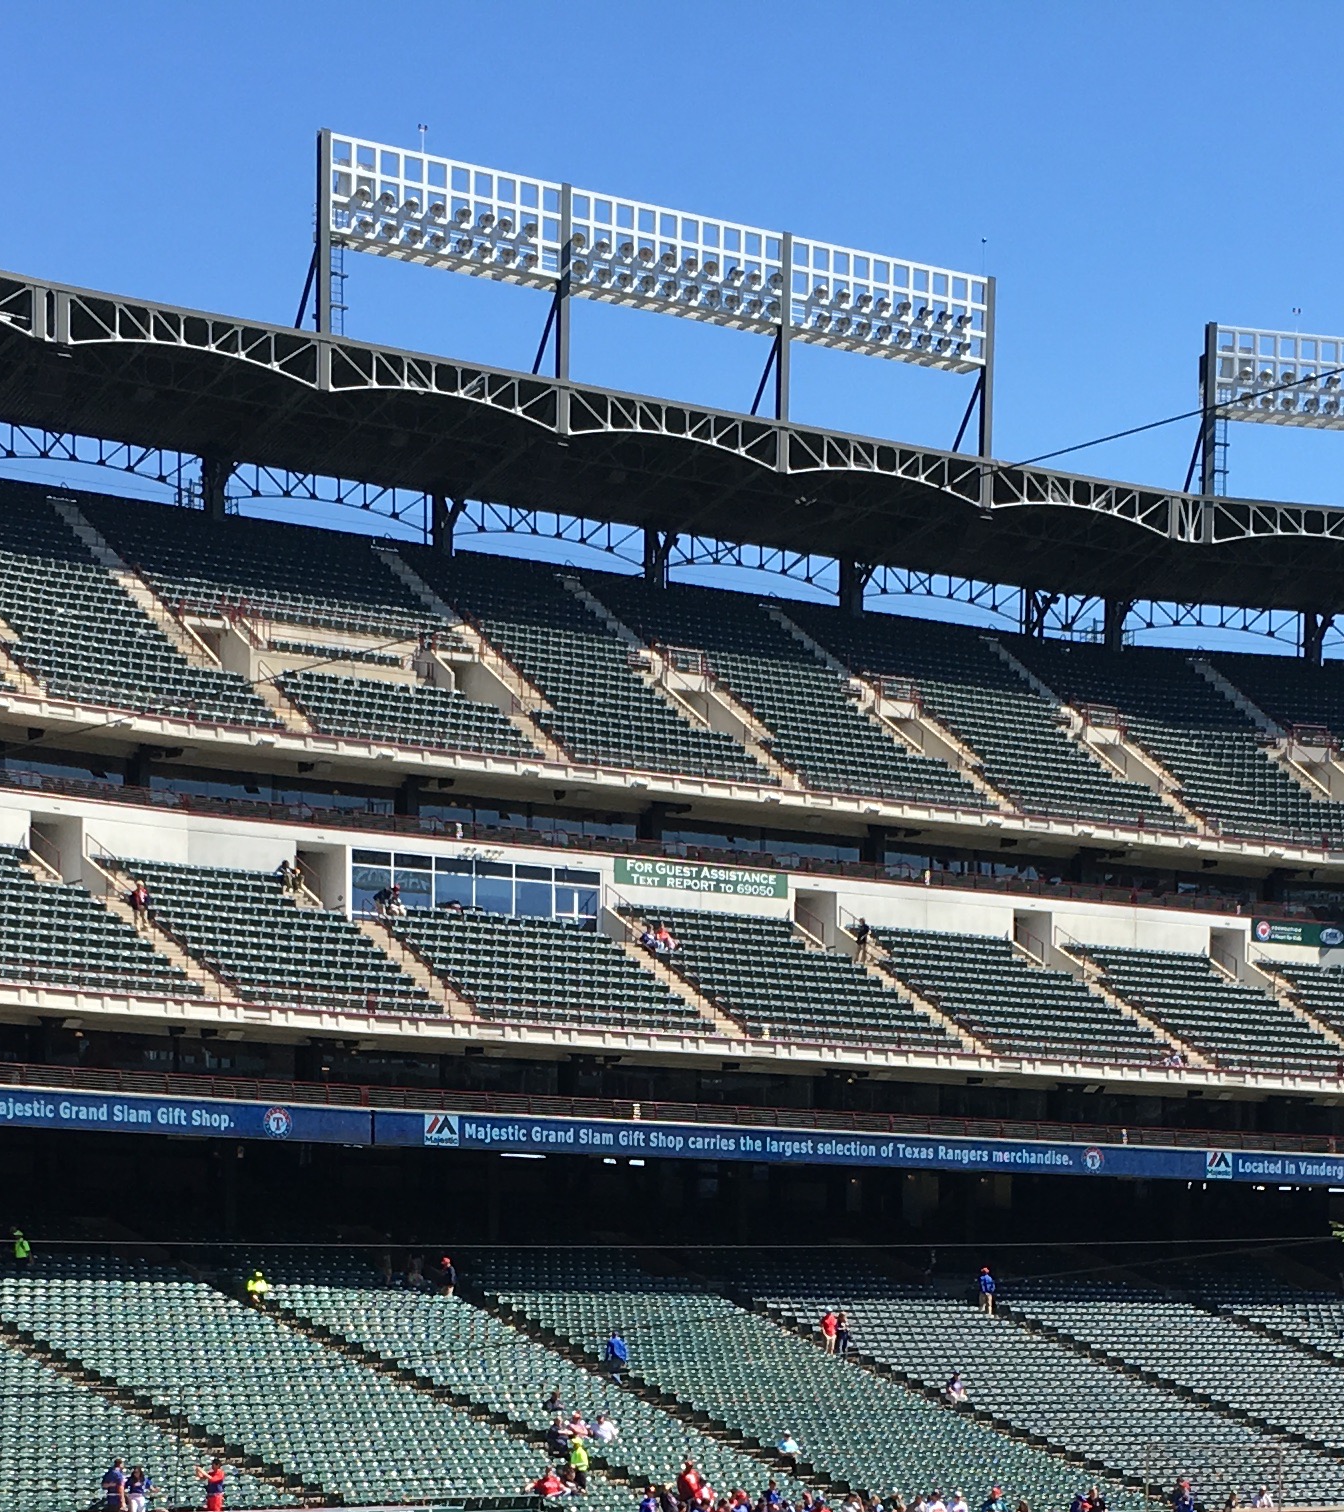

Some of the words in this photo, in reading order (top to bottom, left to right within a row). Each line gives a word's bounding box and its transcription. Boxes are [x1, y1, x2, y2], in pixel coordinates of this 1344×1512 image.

[626, 859, 653, 874] FOR
[655, 862, 700, 879] GUEST
[700, 867, 777, 885] ASSISTANCE
[630, 873, 661, 887] TEXT
[666, 877, 716, 892] REPORT
[719, 883, 735, 893] TO
[736, 885, 775, 897] 69050
[59, 1101, 108, 1122] Grand
[112, 1104, 152, 1125] Slam
[157, 1106, 187, 1127] Gift
[191, 1109, 235, 1131] Shop.
[464, 1123, 527, 1144] Majestic
[531, 1126, 574, 1145] Grand
[578, 1129, 614, 1146] Slam
[618, 1130, 646, 1148] Gift
[649, 1131, 684, 1151] Shop
[687, 1134, 736, 1151] carries
[740, 1135, 762, 1152] the
[766, 1136, 814, 1158] largest
[816, 1139, 877, 1158] selection
[880, 1142, 894, 1158] of
[896, 1143, 935, 1160] Texas
[938, 1145, 989, 1165] Rangers
[992, 1148, 1074, 1167] merchandise.
[1238, 1158, 1282, 1175] Located
[1285, 1162, 1296, 1175] in
